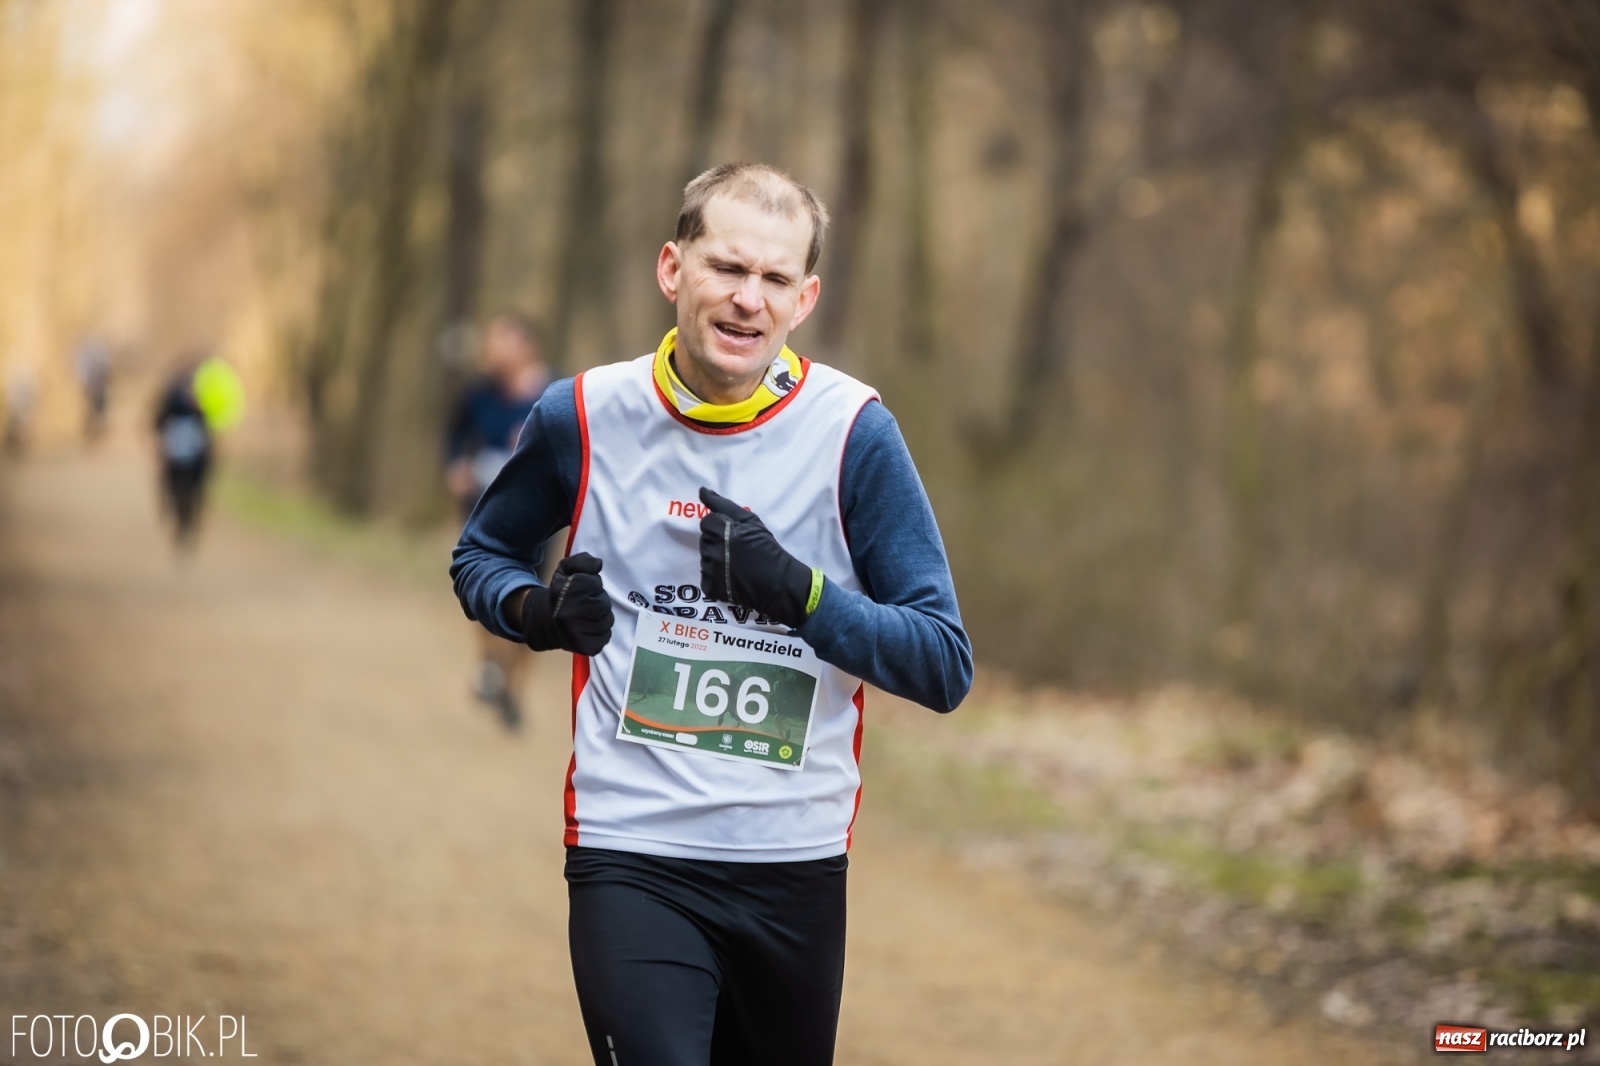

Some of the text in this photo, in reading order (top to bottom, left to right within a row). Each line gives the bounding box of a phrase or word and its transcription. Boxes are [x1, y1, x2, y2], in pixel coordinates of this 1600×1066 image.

[660, 620, 803, 658] X BIEG Twardziela
[666, 638, 690, 649] lutego
[690, 642, 707, 651] 2022
[673, 662, 771, 724] 166
